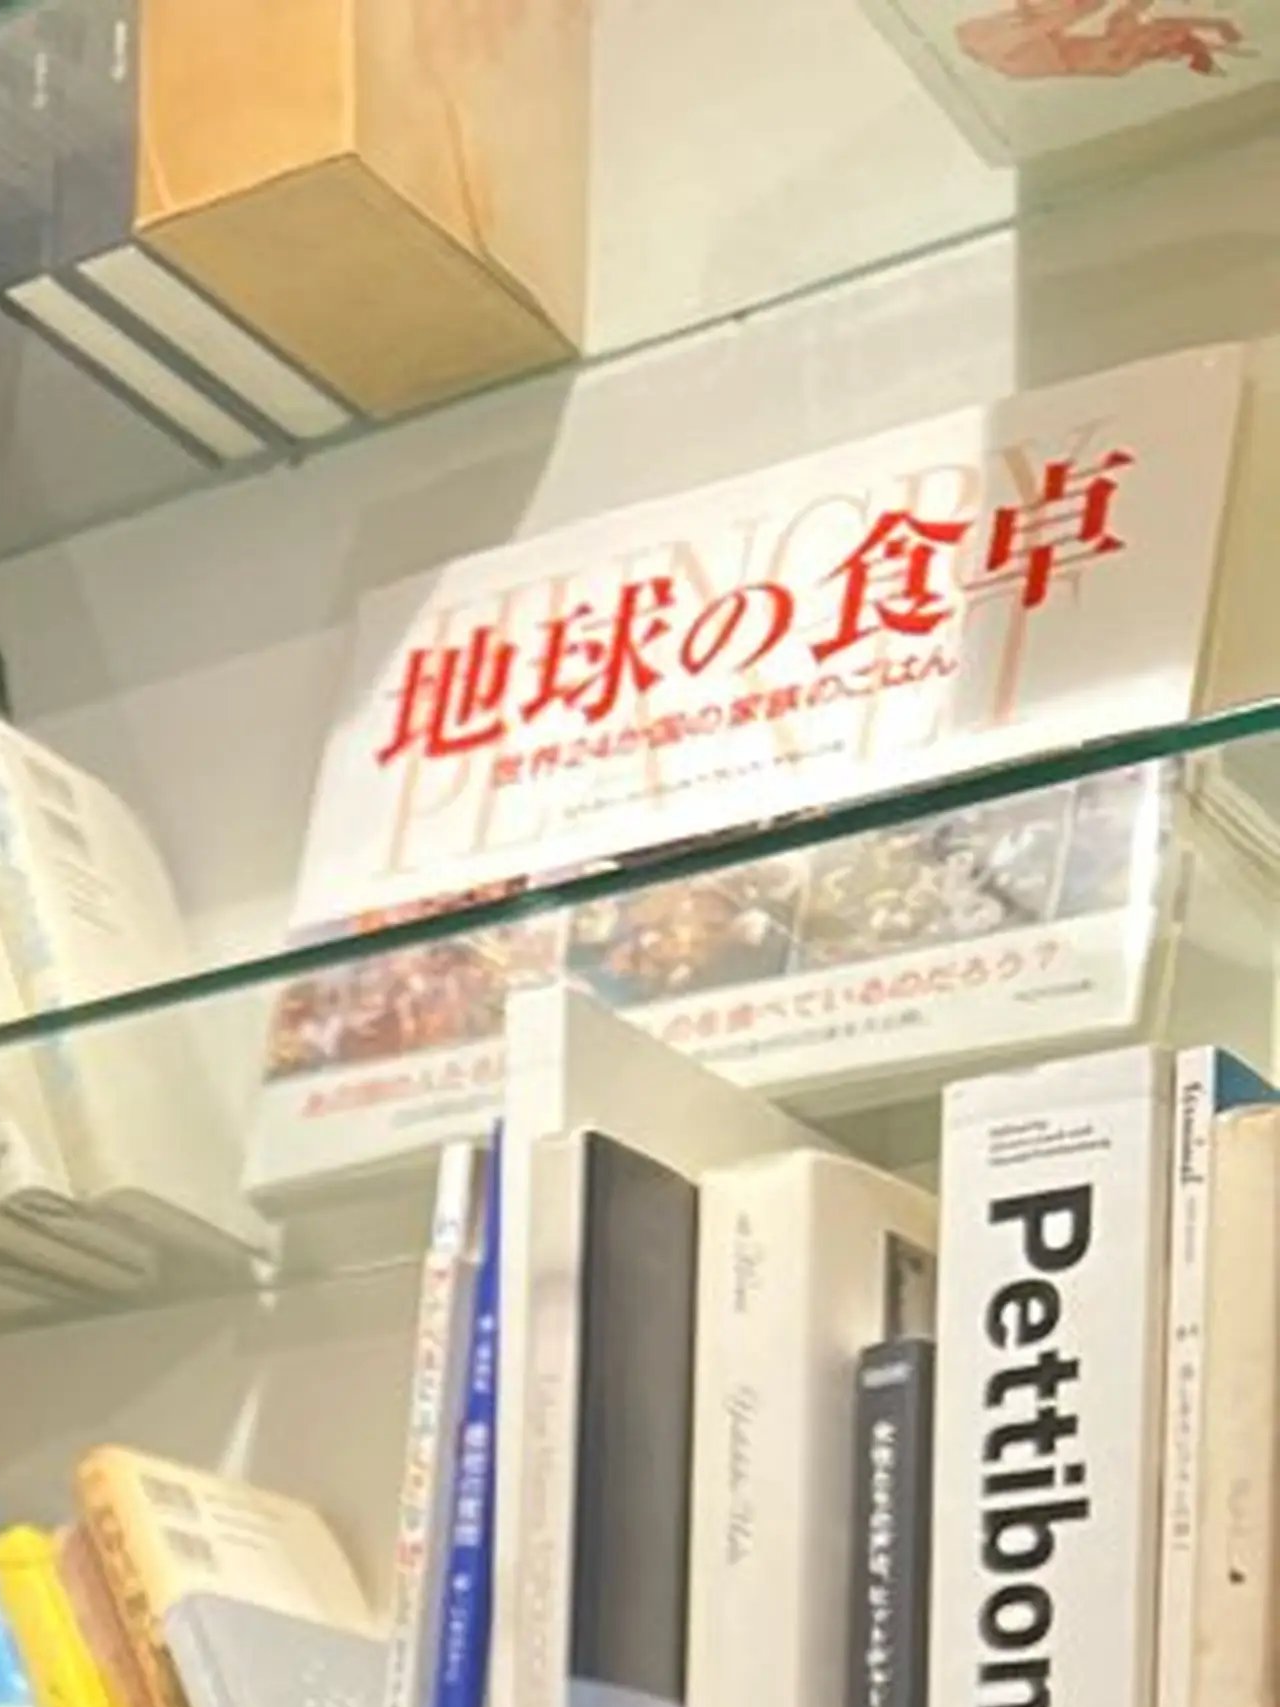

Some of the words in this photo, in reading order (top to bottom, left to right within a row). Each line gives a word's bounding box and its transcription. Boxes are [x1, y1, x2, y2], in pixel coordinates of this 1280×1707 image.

[376, 447, 1136, 768] 地球の食卓
